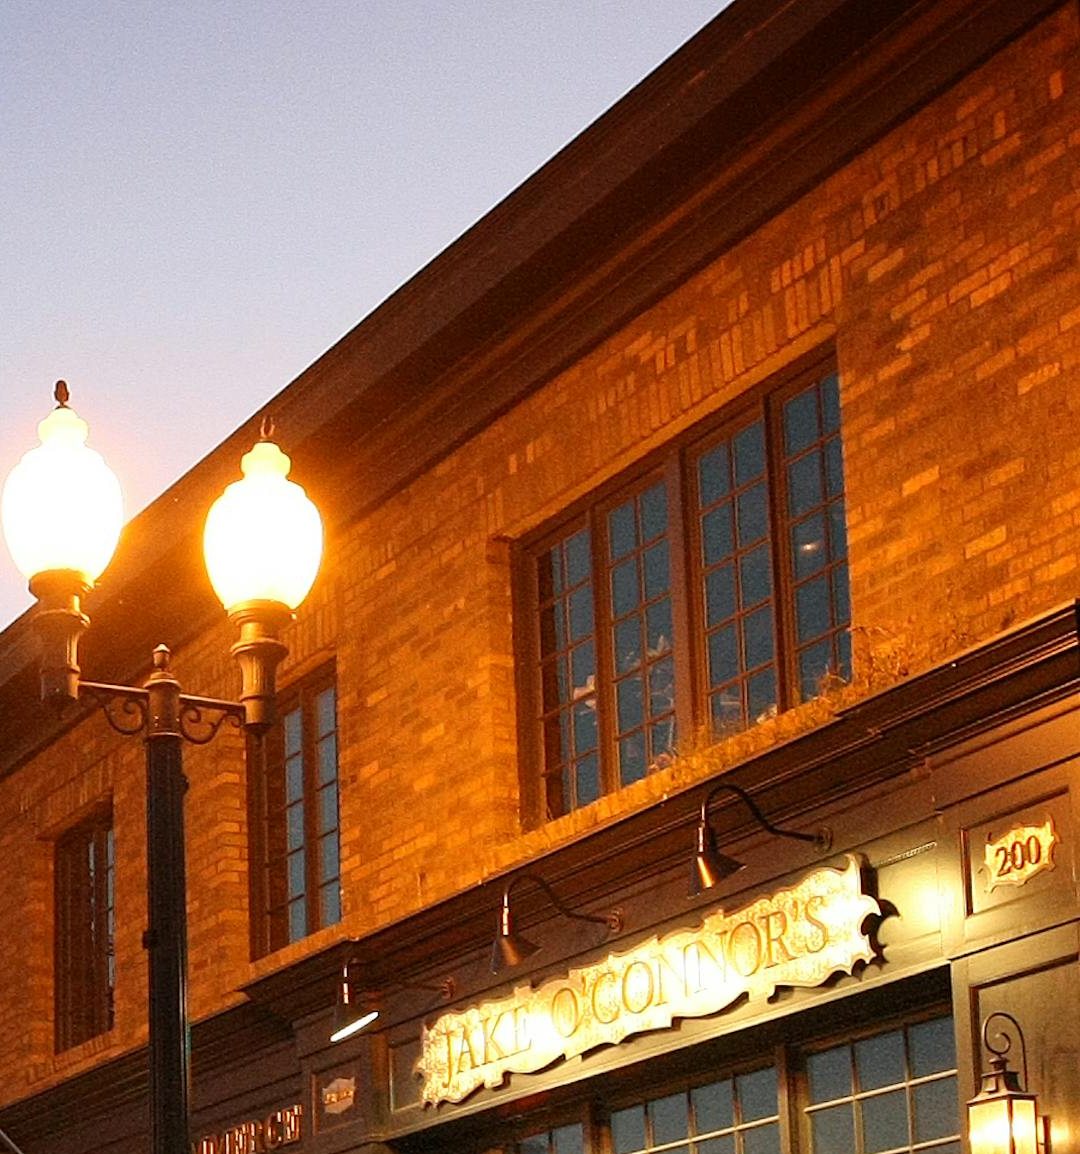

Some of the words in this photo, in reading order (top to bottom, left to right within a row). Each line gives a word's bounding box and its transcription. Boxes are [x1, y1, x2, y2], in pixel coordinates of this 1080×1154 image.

[995, 835, 1041, 877] 200
[438, 1003, 533, 1089] JAKE
[551, 895, 828, 1037] O'CONNOR'S
